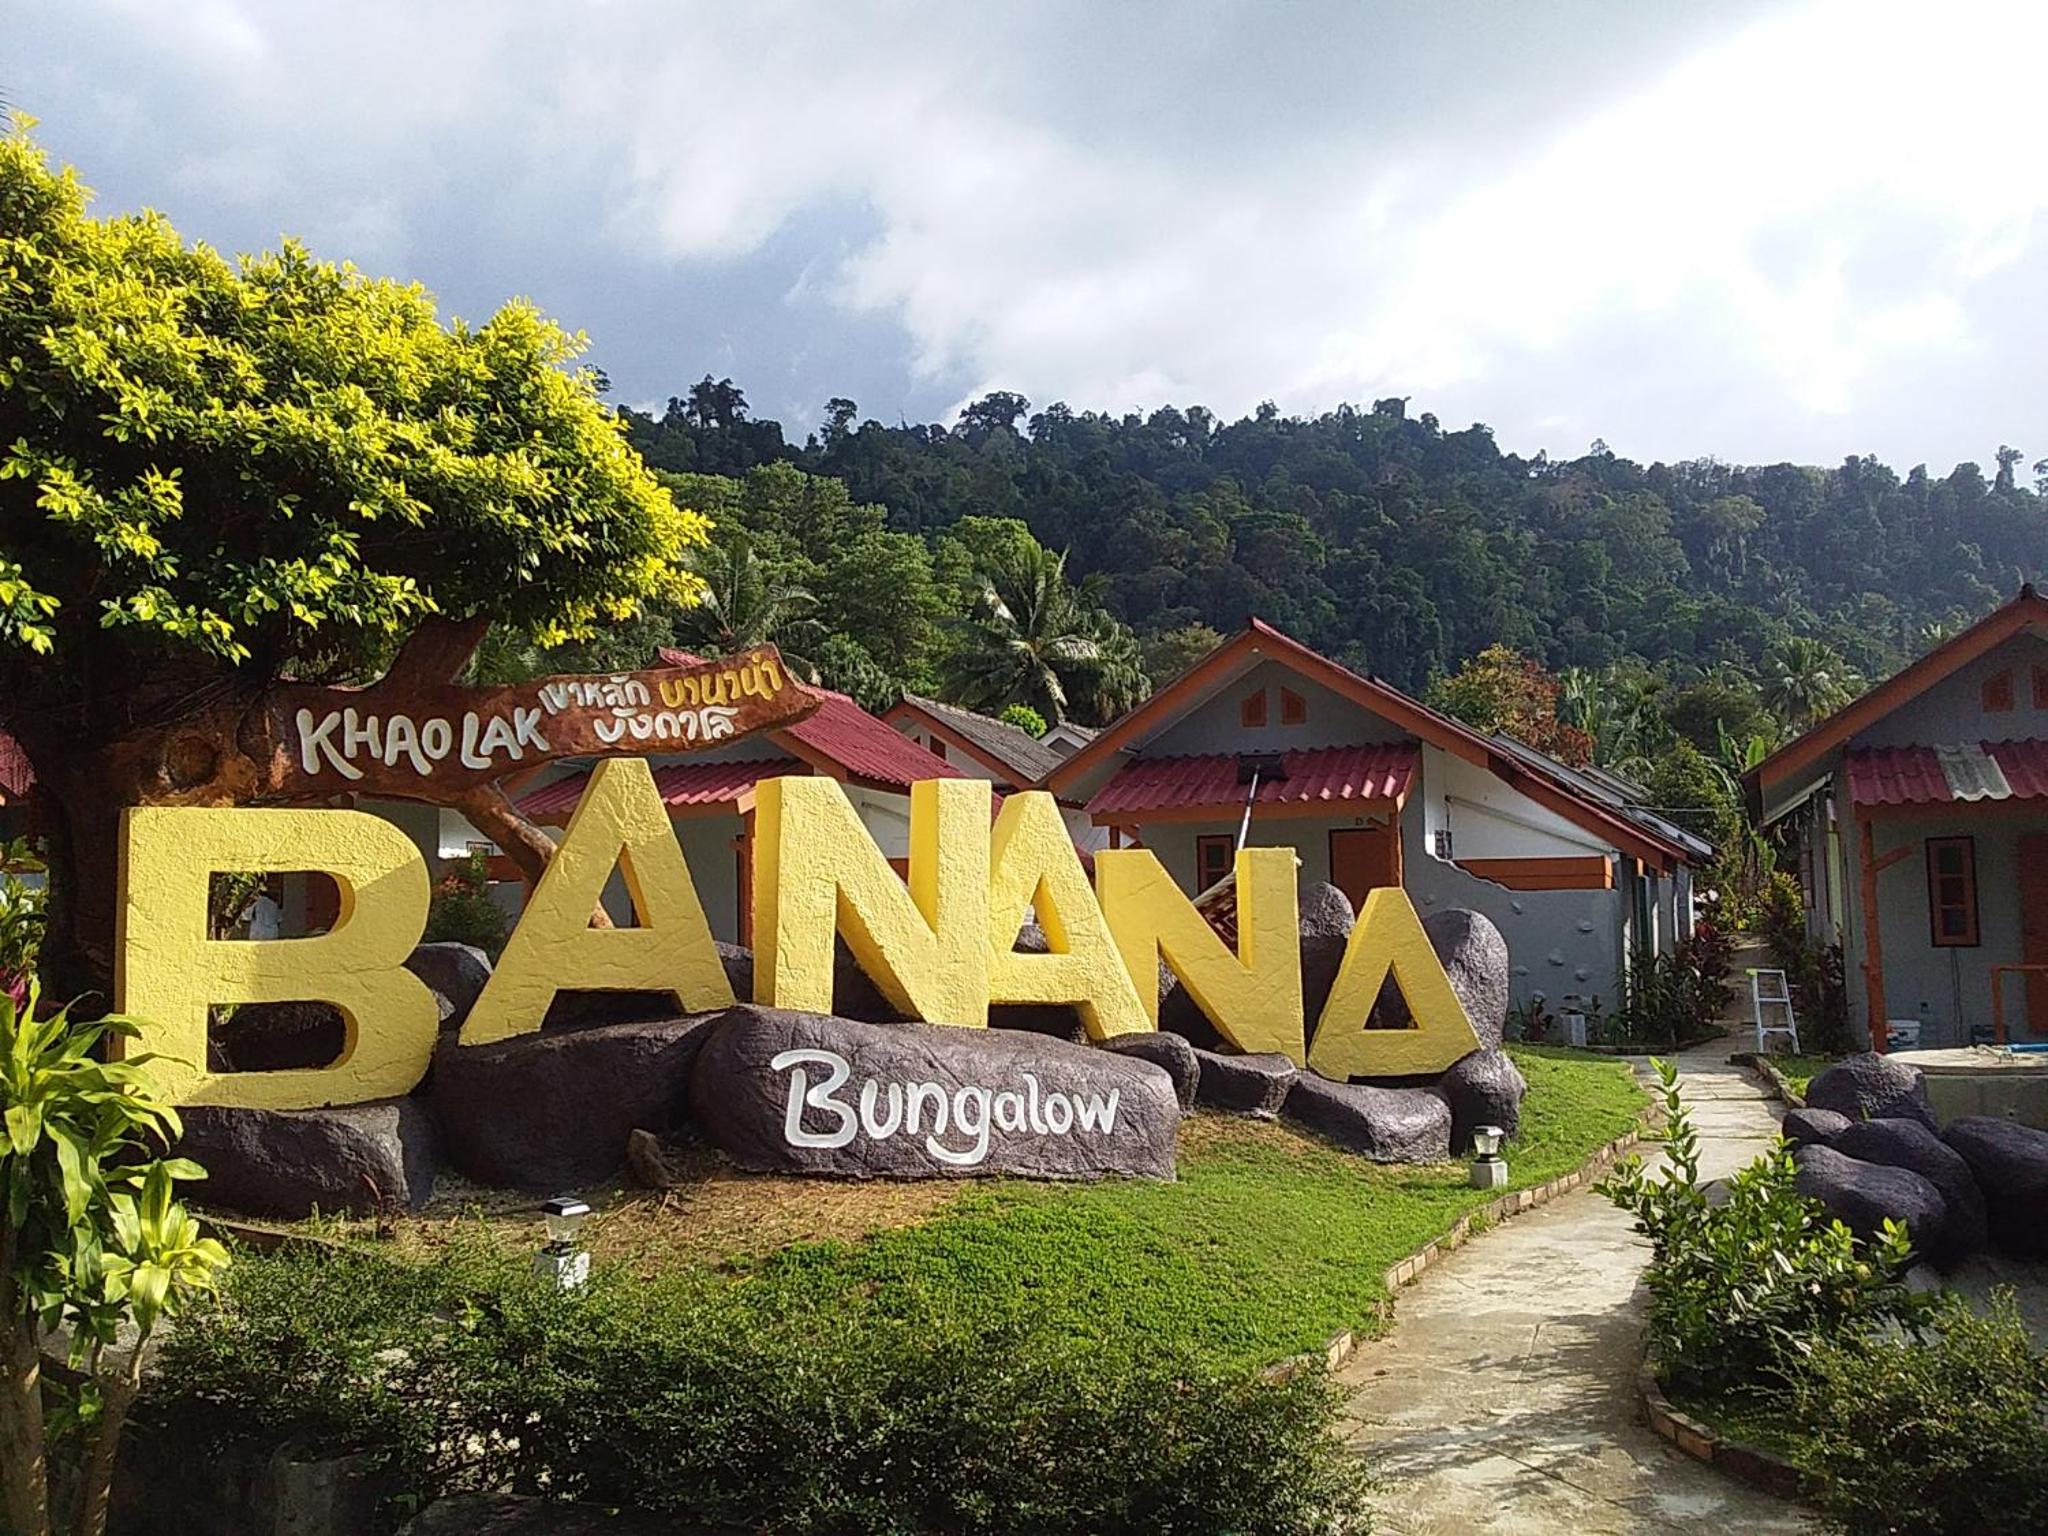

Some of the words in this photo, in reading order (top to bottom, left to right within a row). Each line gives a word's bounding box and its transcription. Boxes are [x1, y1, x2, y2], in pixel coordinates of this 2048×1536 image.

[538, 674, 650, 716] เขาหลัก
[658, 652, 783, 704] บานาน่า
[296, 706, 453, 780] KHAO
[460, 706, 550, 770] LAK
[114, 757, 1483, 1110] BANANA
[770, 1049, 1119, 1165] Bungalow
